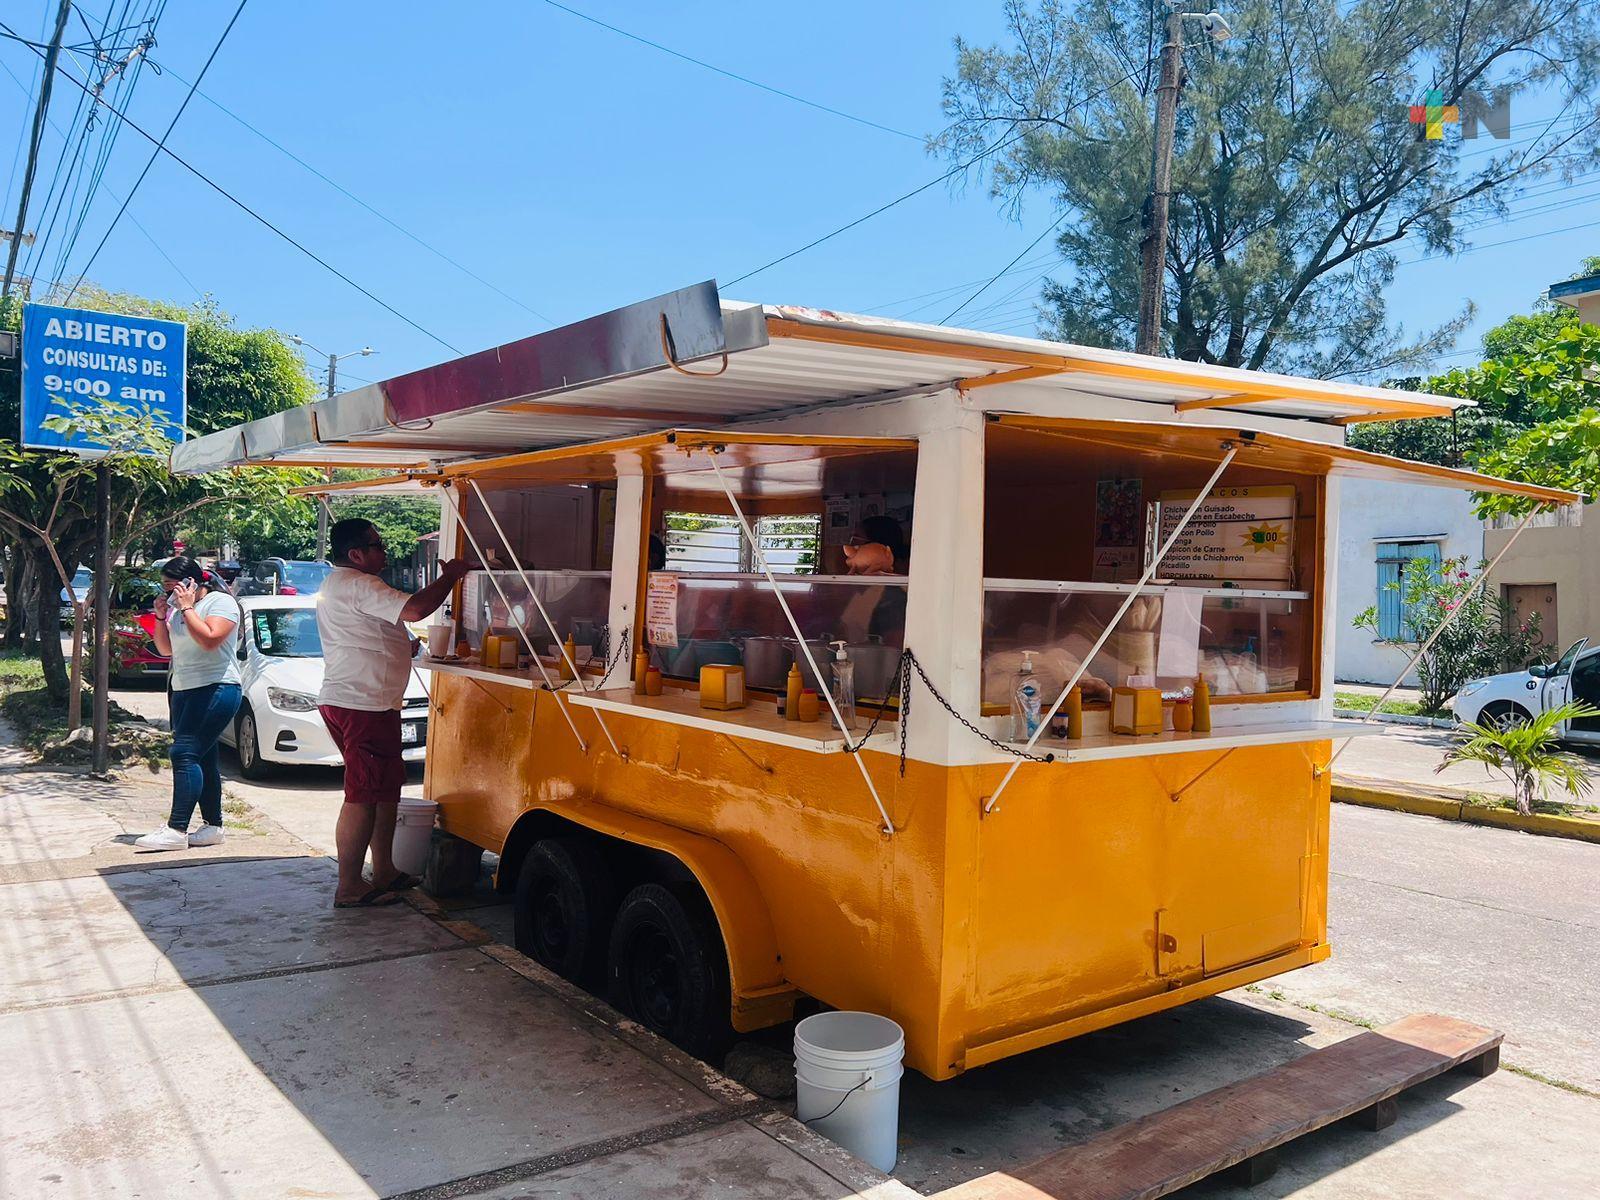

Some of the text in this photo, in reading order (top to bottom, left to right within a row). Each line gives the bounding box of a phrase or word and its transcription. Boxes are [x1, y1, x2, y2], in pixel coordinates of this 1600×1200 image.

[44, 317, 167, 351] ABIERTO
[42, 347, 167, 377] CONSULTAS DE:
[43, 374, 166, 403] 9:00 am
[1164, 504, 1235, 514] Chichan Guisado
[1214, 512, 1256, 520] Escabeche
[1198, 520, 1217, 528] Pollo
[1196, 528, 1214, 536] Pollo
[1162, 537, 1192, 546] Monga
[1167, 545, 1191, 553] lpicon
[1203, 545, 1226, 553] Carne
[1192, 553, 1202, 561] de
